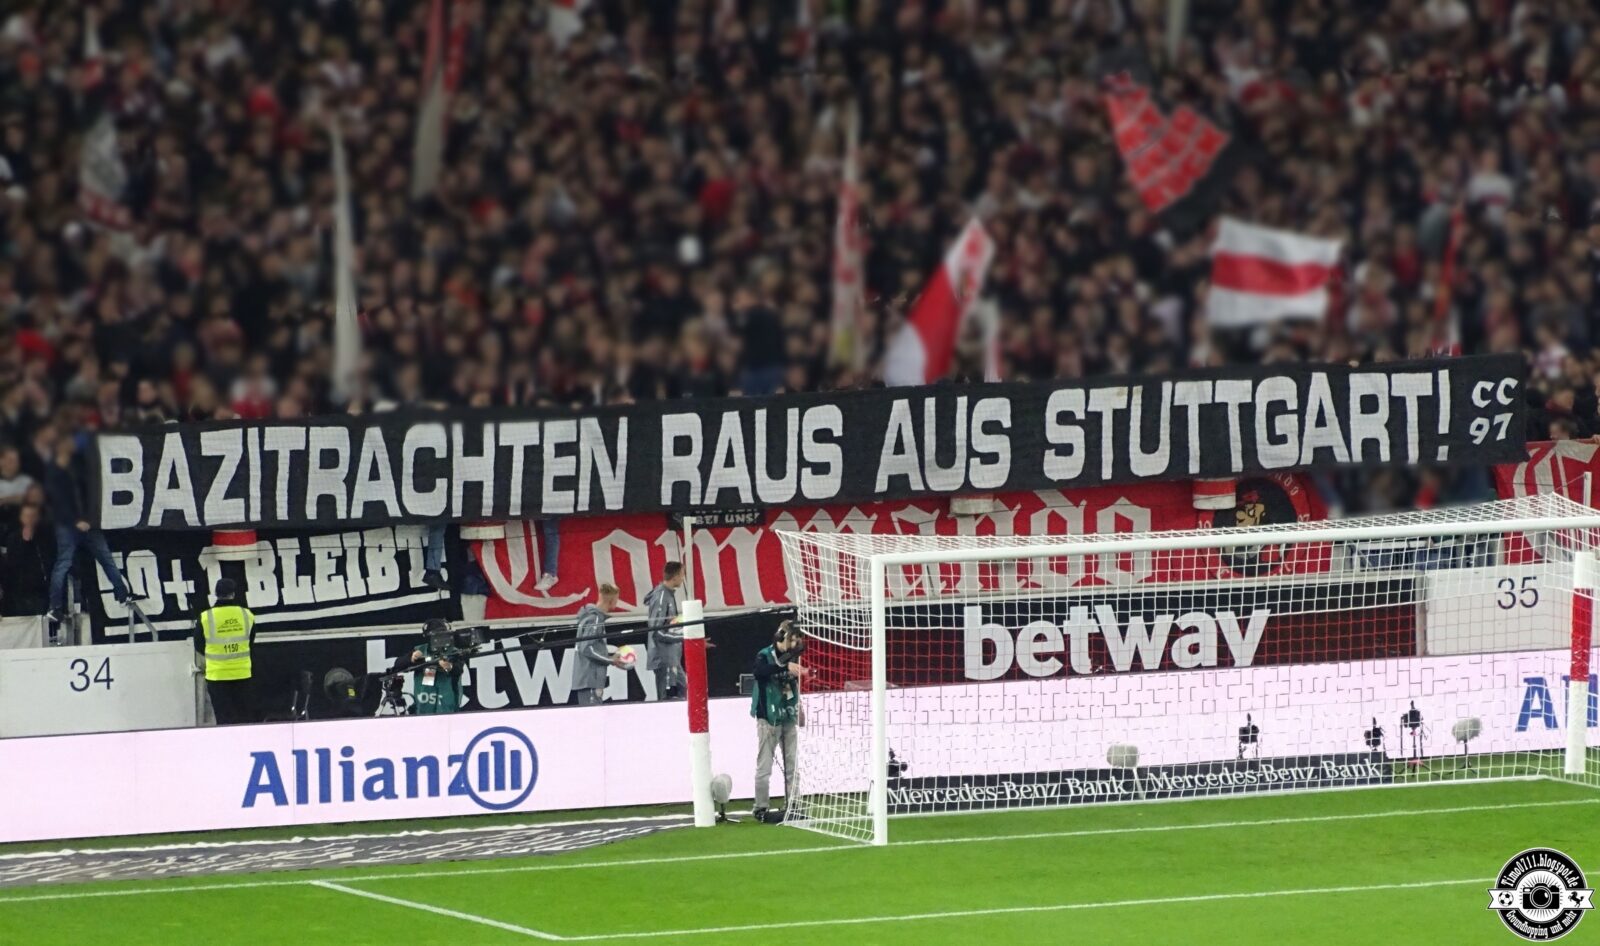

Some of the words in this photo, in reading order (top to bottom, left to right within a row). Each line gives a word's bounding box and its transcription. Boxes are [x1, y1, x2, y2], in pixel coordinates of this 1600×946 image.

[1471, 377, 1518, 408] CC
[1469, 413, 1513, 445] 97
[101, 418, 628, 530] BAZITRACHTEN
[661, 405, 843, 507] RAUS
[875, 397, 1012, 494] AUS
[1043, 370, 1451, 481] STUTTGART!
[1497, 576, 1539, 610] 35
[964, 603, 1271, 680] betway
[70, 656, 114, 692] 34
[241, 745, 469, 808] Allianz
[1067, 775, 1130, 797] Bank
[1149, 763, 1318, 791] Mercedes-Benz
[1321, 758, 1381, 780] Bank
